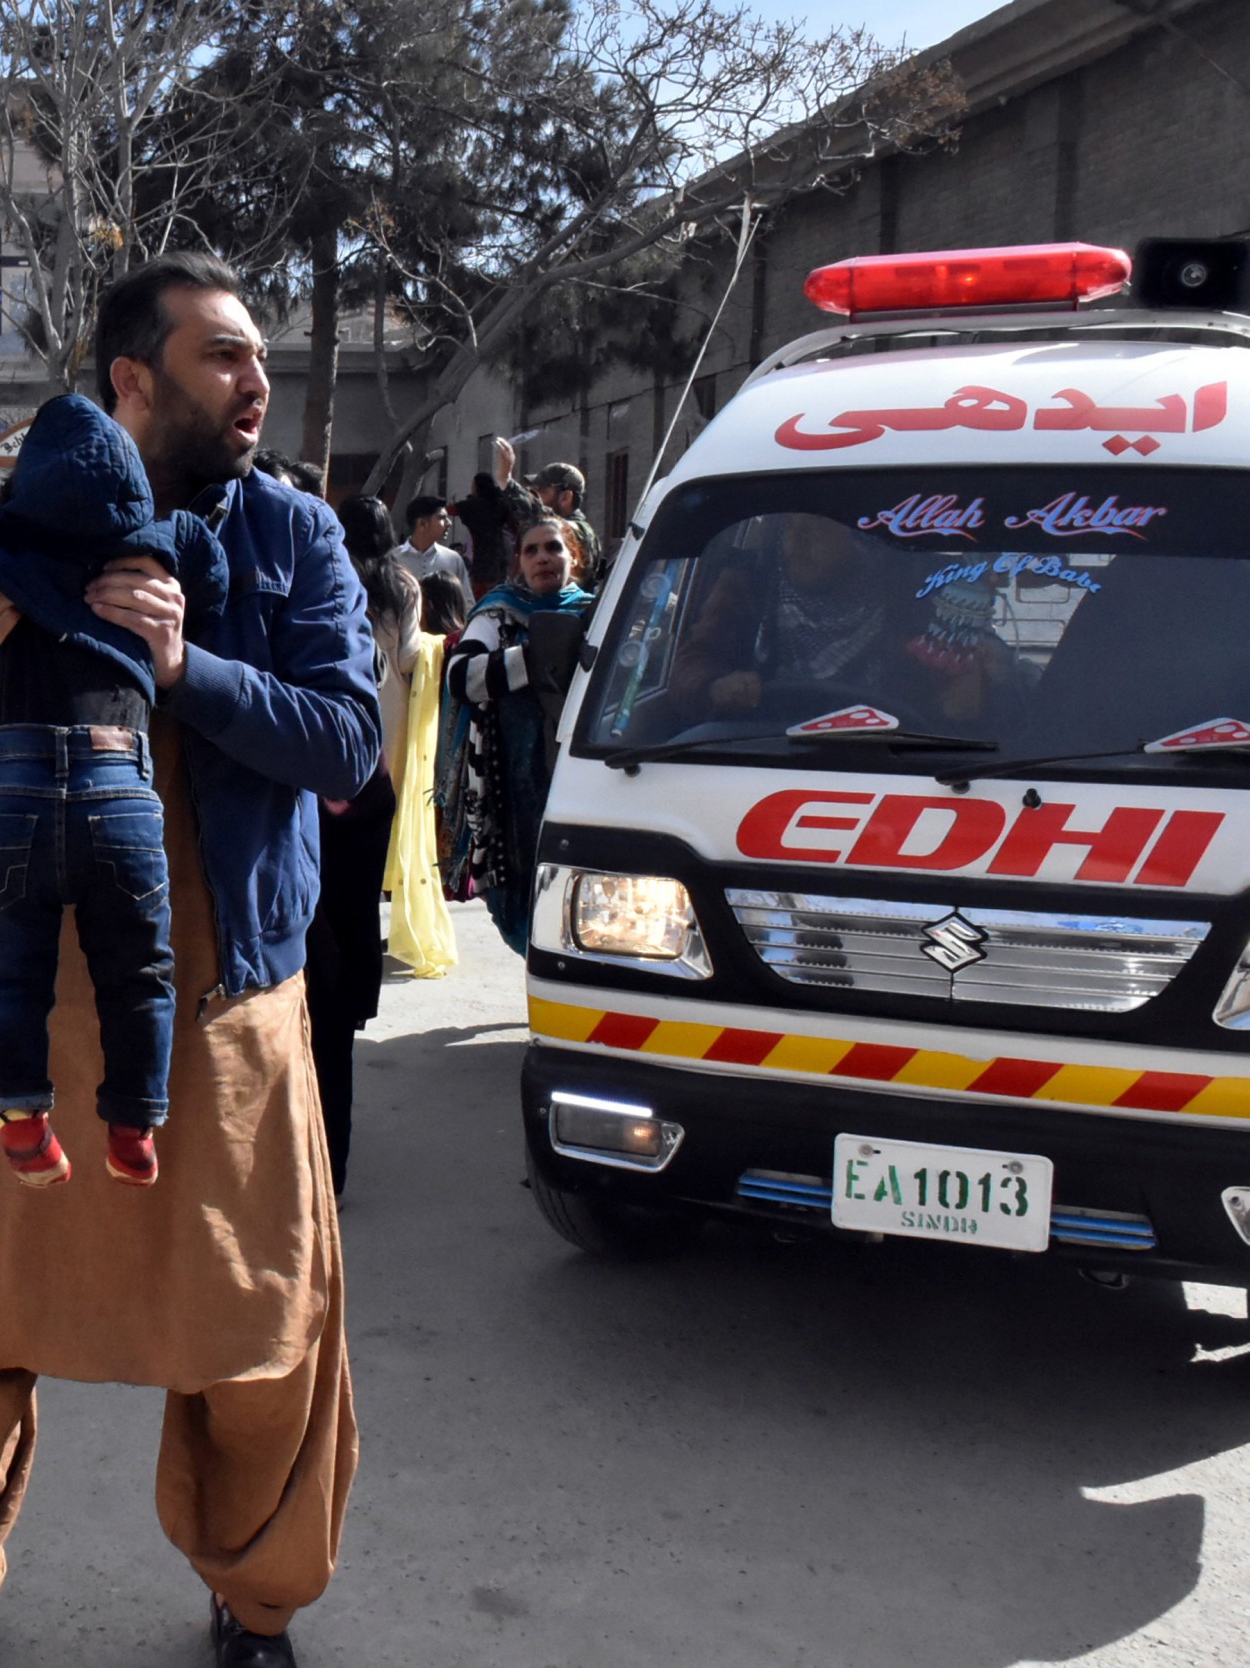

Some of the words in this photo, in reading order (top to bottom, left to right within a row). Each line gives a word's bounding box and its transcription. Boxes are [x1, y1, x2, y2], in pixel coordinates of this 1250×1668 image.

[857, 493, 986, 543] Allah
[1004, 492, 1168, 542] Akbar
[736, 788, 1226, 887] EDHI
[901, 1210, 978, 1235] SINDH
